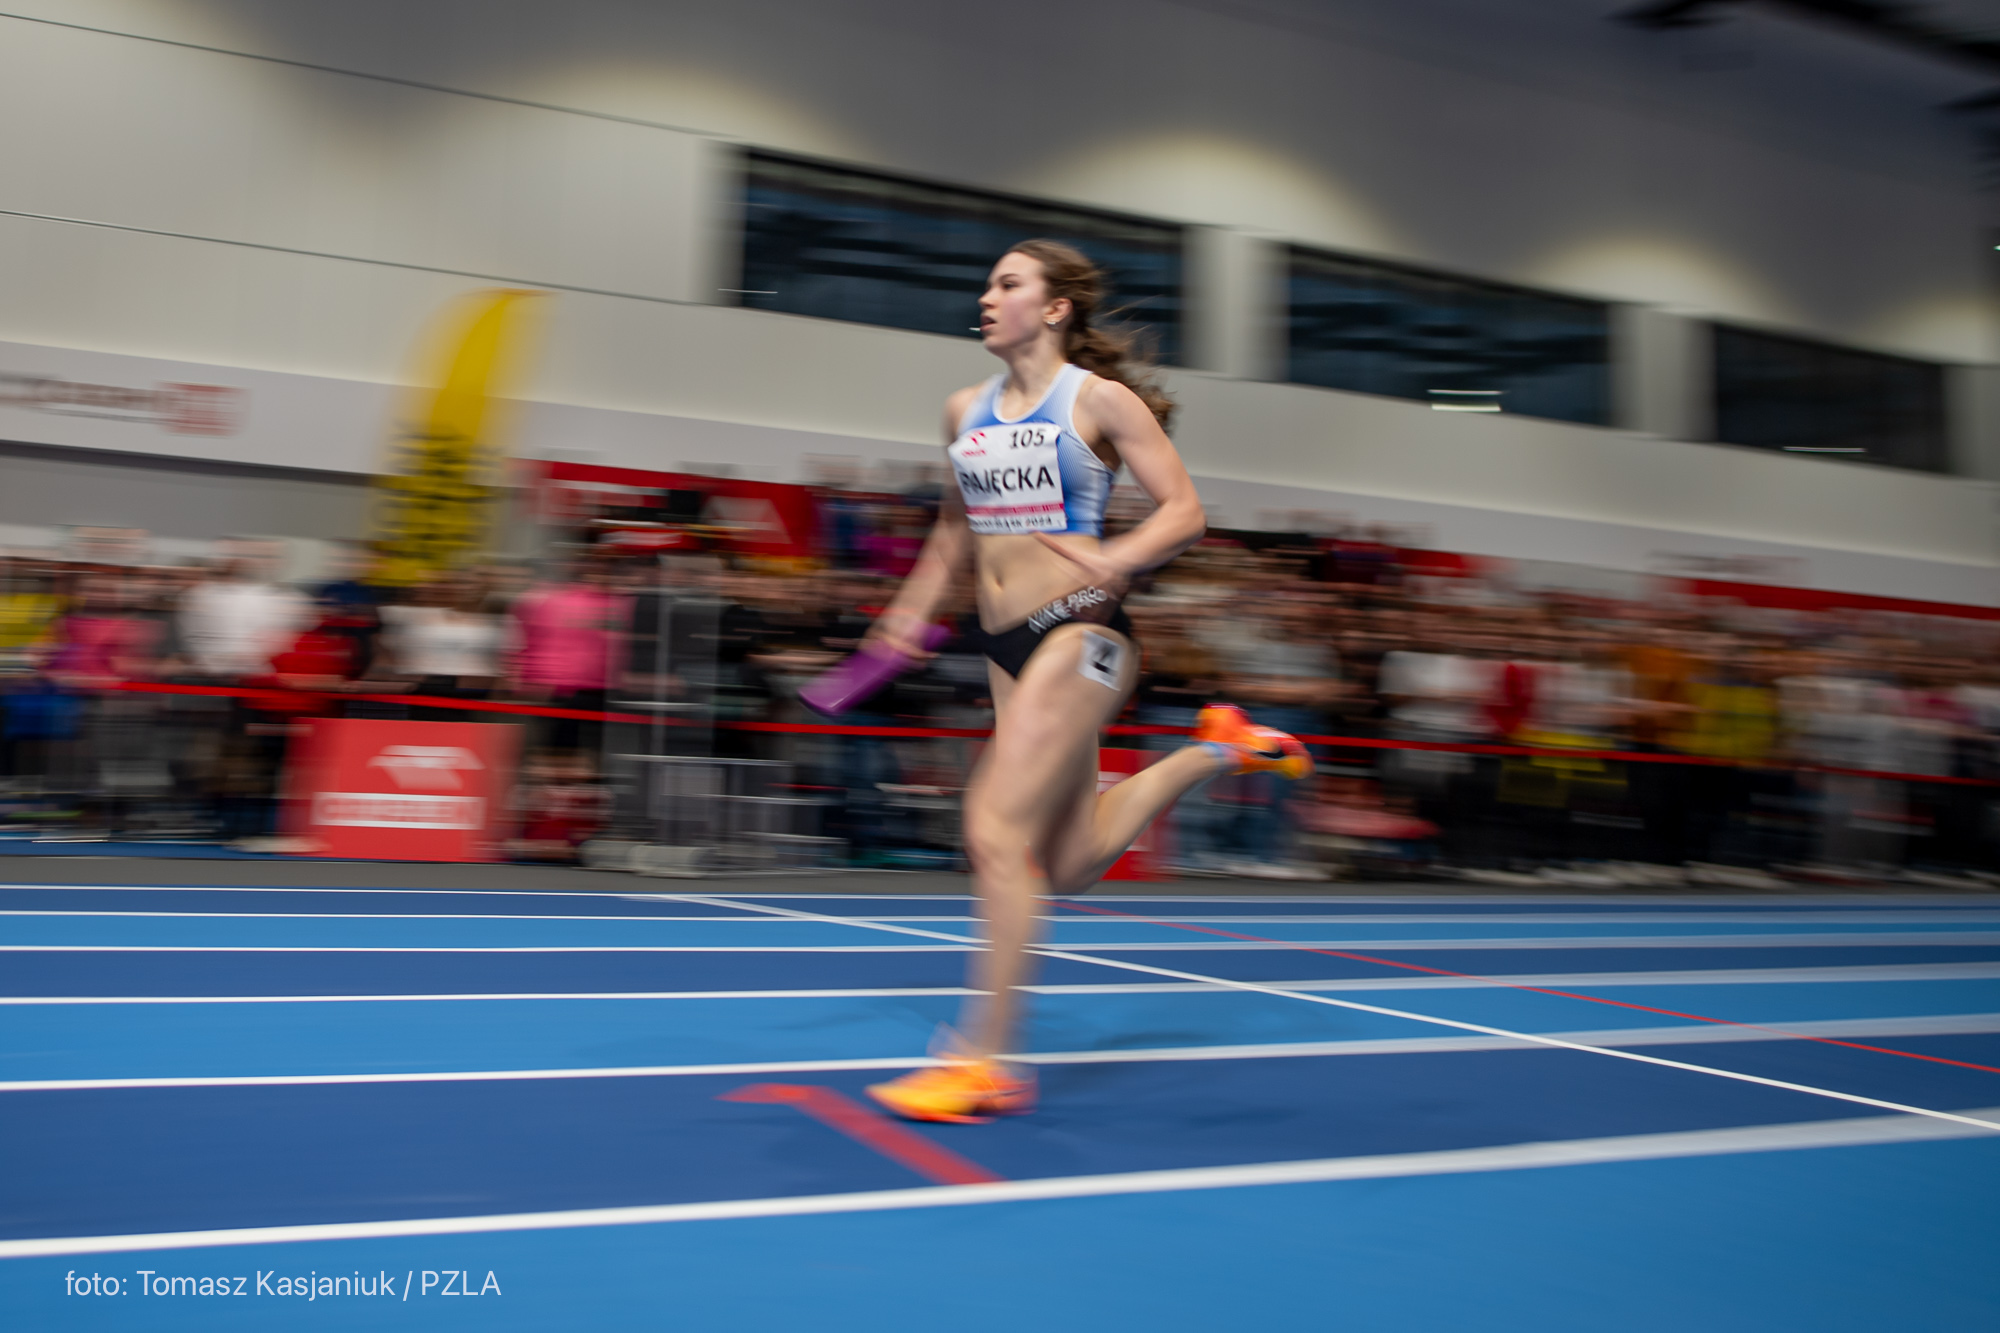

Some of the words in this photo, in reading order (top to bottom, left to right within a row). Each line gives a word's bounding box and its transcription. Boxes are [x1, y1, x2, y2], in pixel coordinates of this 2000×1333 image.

[1009, 428, 1047, 449] 105
[1028, 599, 1073, 634] NIKE
[1067, 585, 1108, 613] PRO
